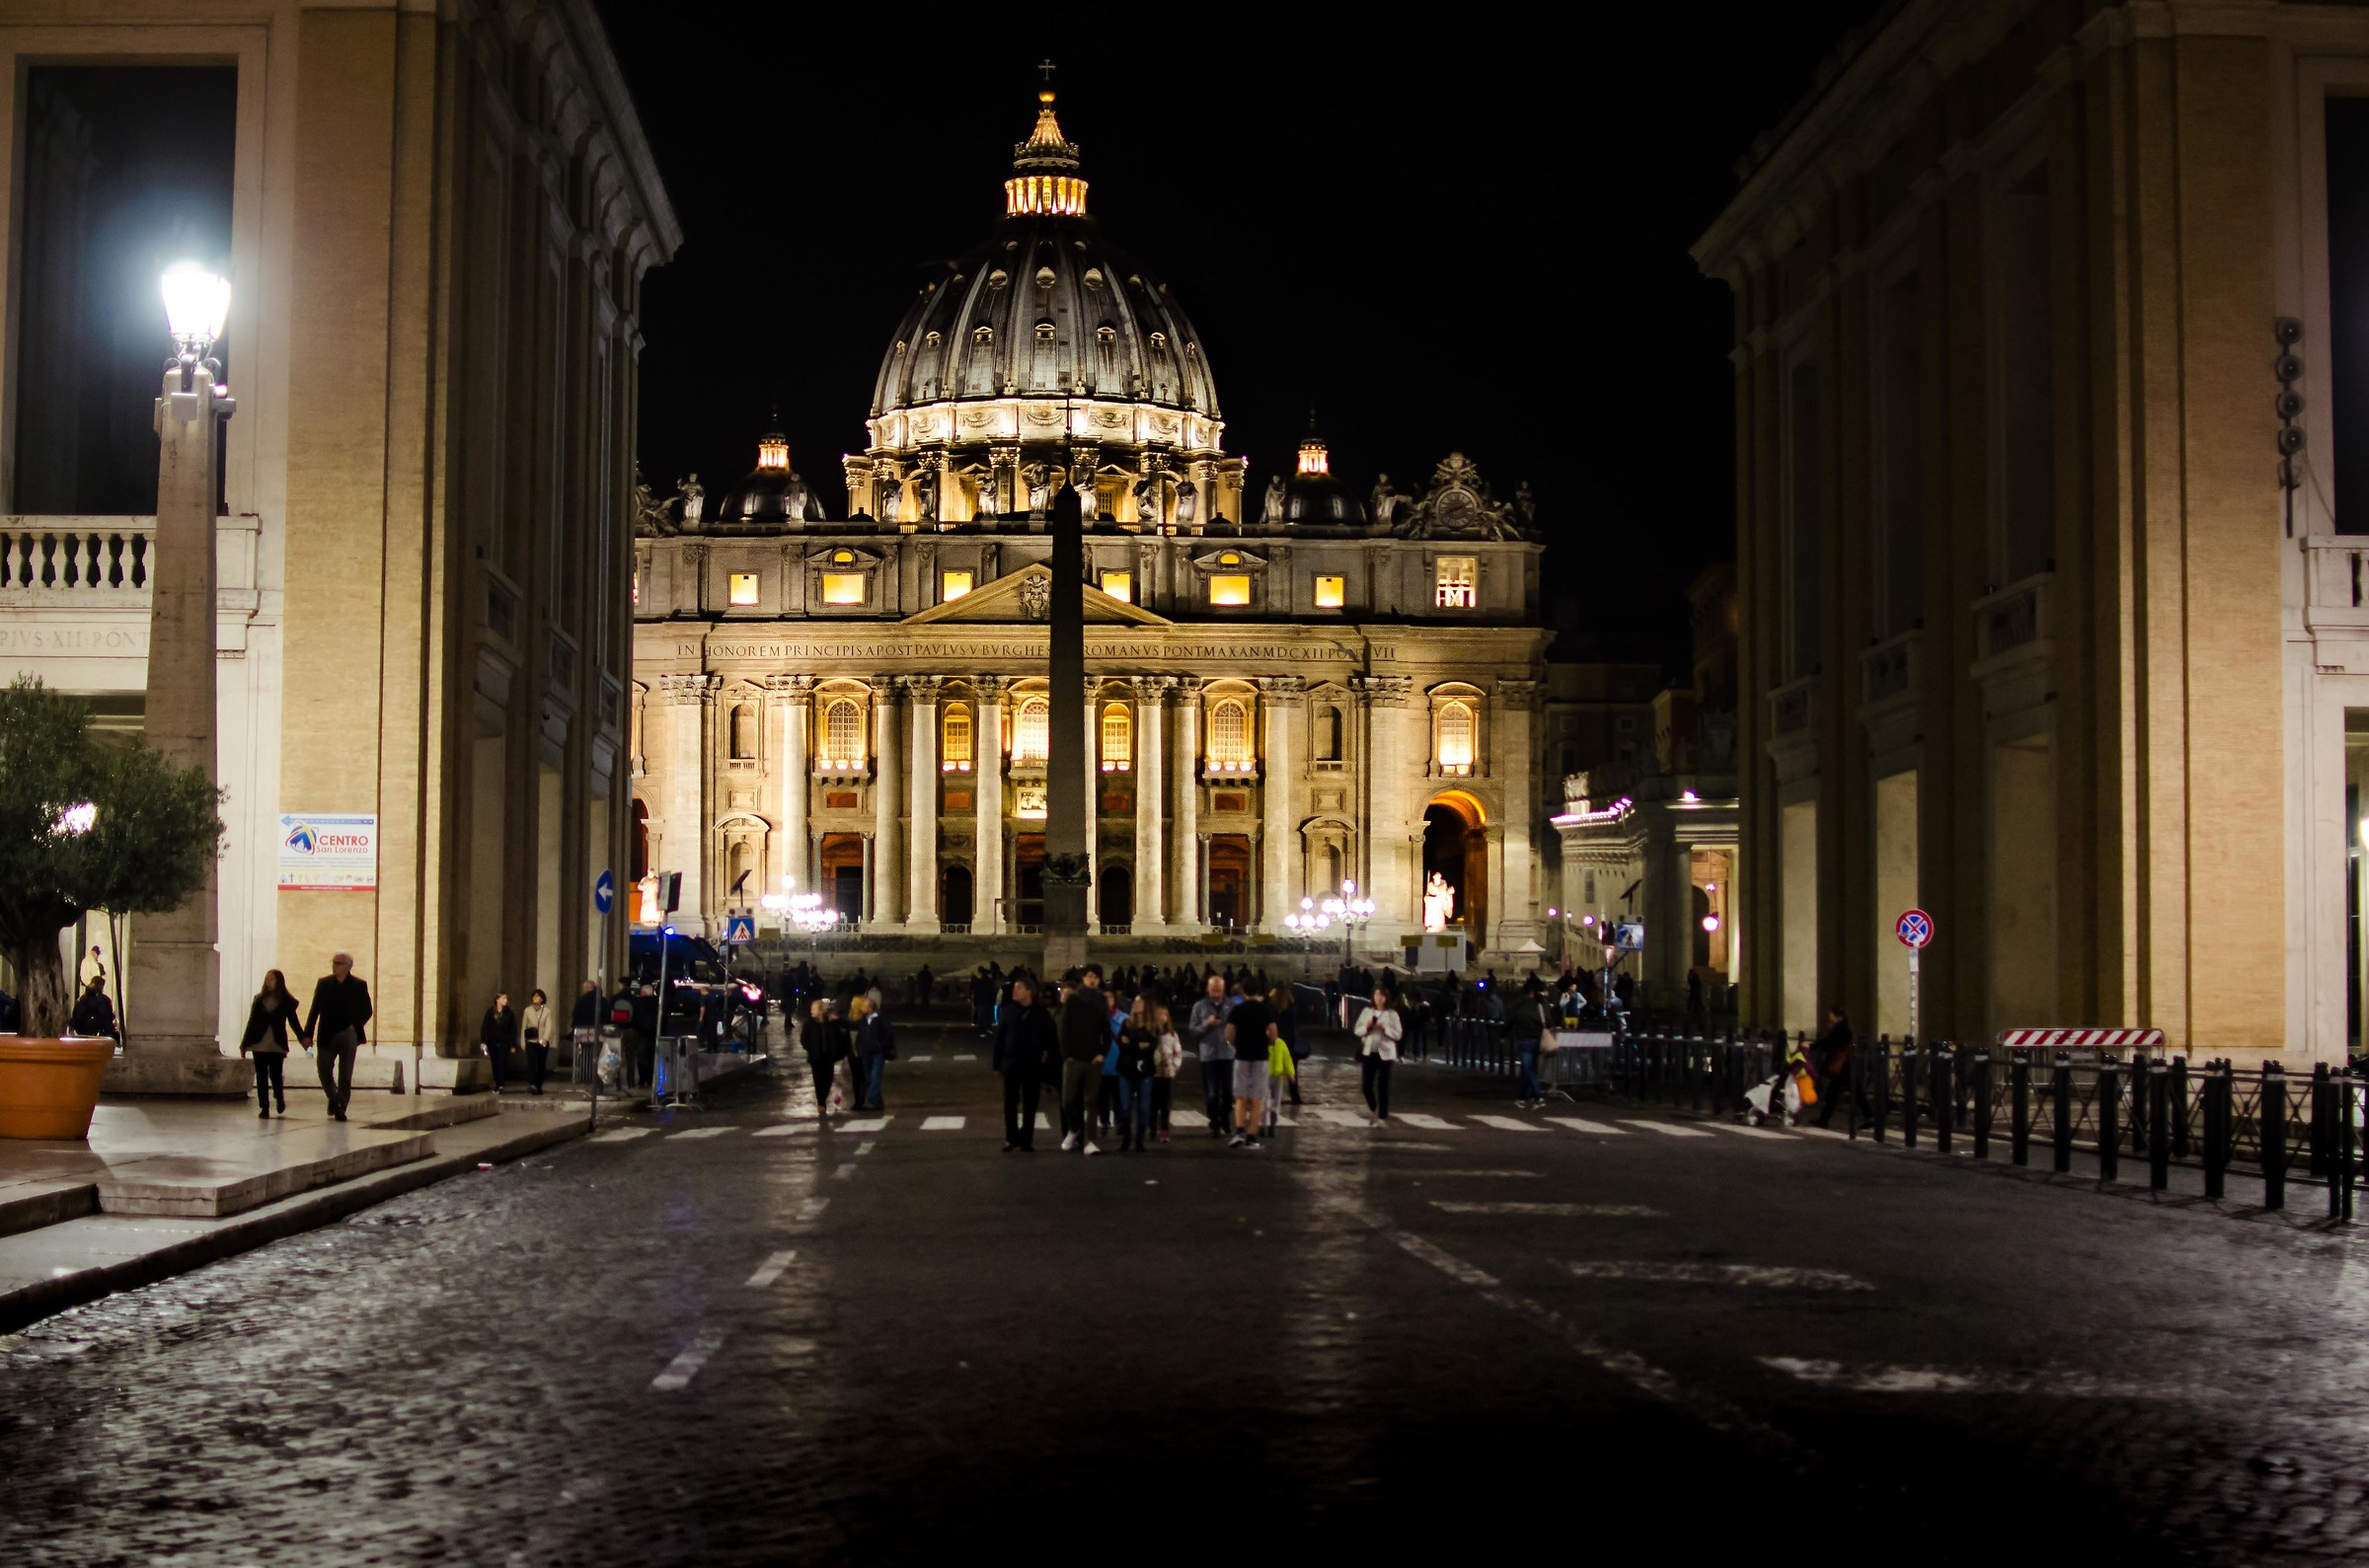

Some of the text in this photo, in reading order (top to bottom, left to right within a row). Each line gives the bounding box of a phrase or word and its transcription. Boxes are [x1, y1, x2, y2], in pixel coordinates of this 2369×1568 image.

[677, 644, 695, 655] IN
[705, 644, 780, 656] HONOREM
[319, 835, 369, 846] CENTRO
